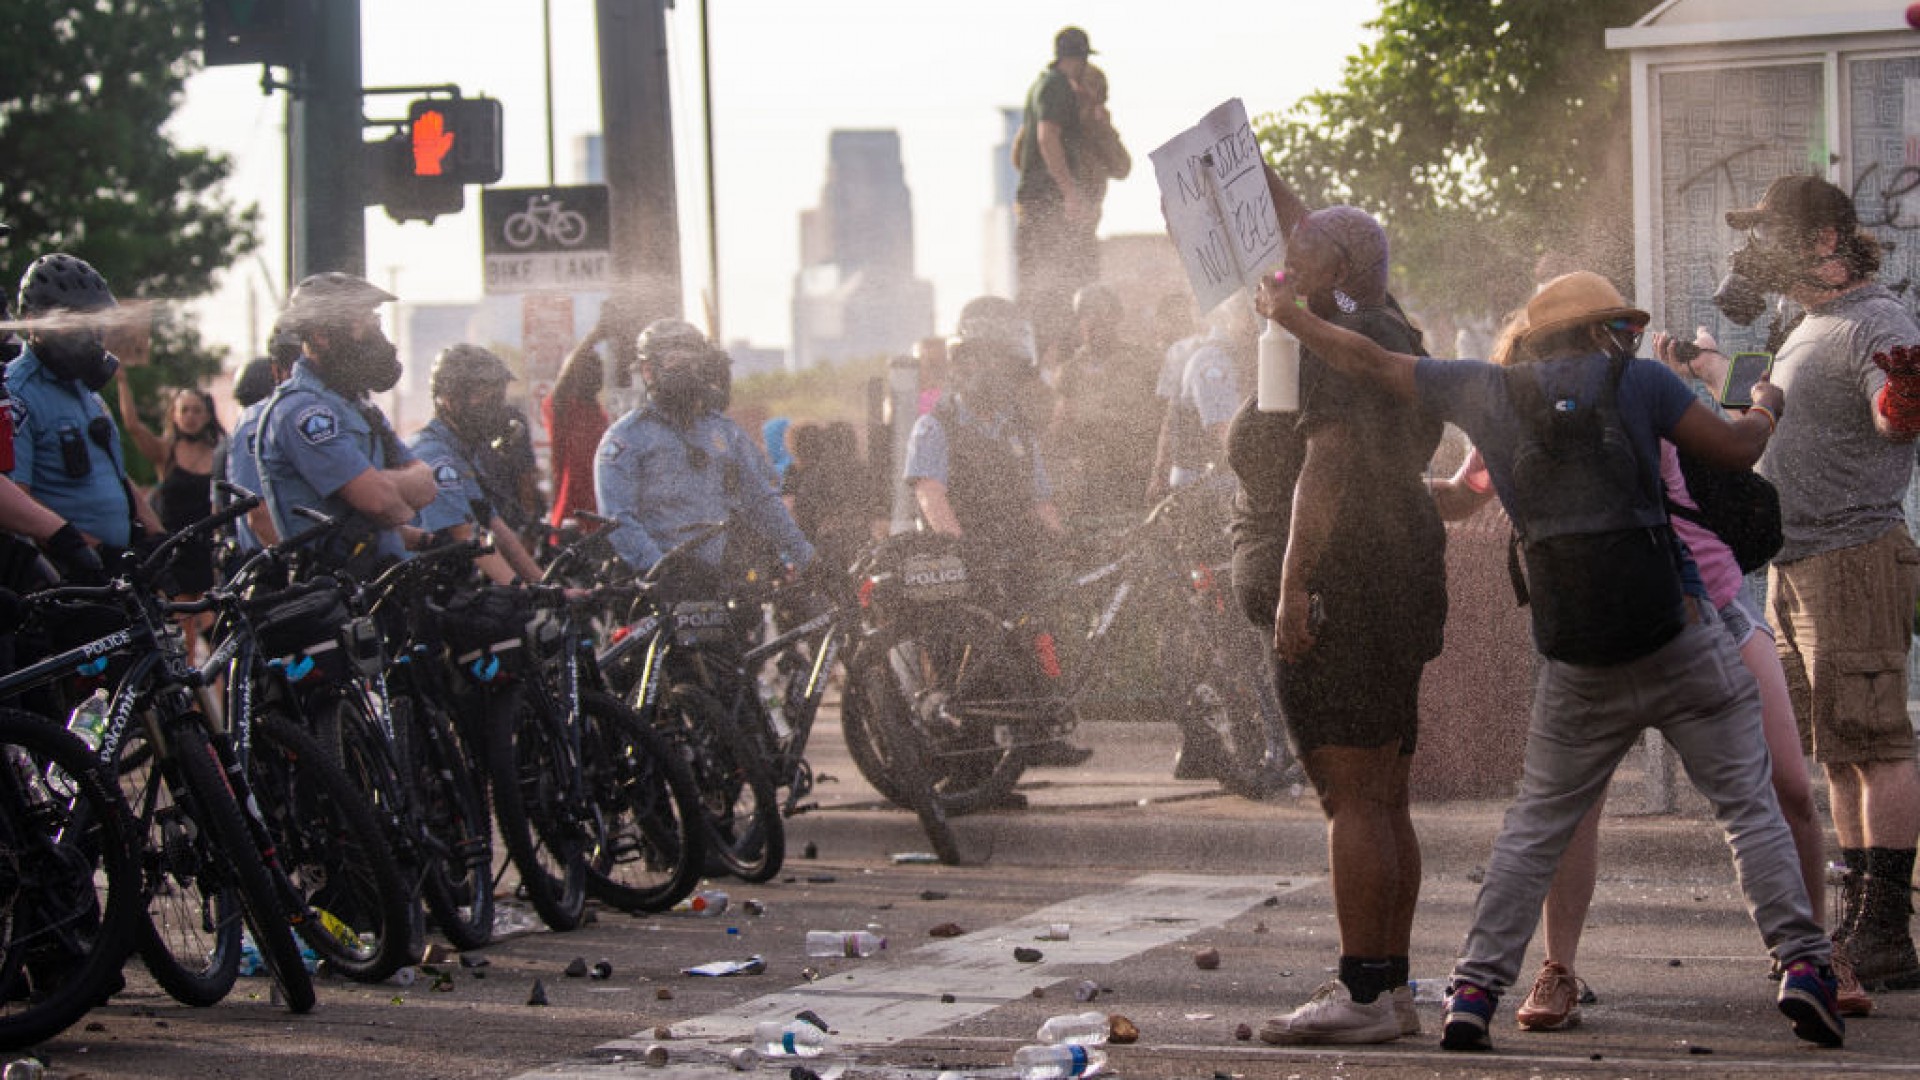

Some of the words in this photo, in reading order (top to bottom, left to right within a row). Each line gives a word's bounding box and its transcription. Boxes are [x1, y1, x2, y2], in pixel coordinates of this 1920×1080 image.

[1195, 229, 1230, 284] NO
[486, 259, 533, 287] BIKE
[553, 257, 606, 284] LANE
[904, 567, 967, 585] POLICE
[83, 627, 132, 658] POLICE
